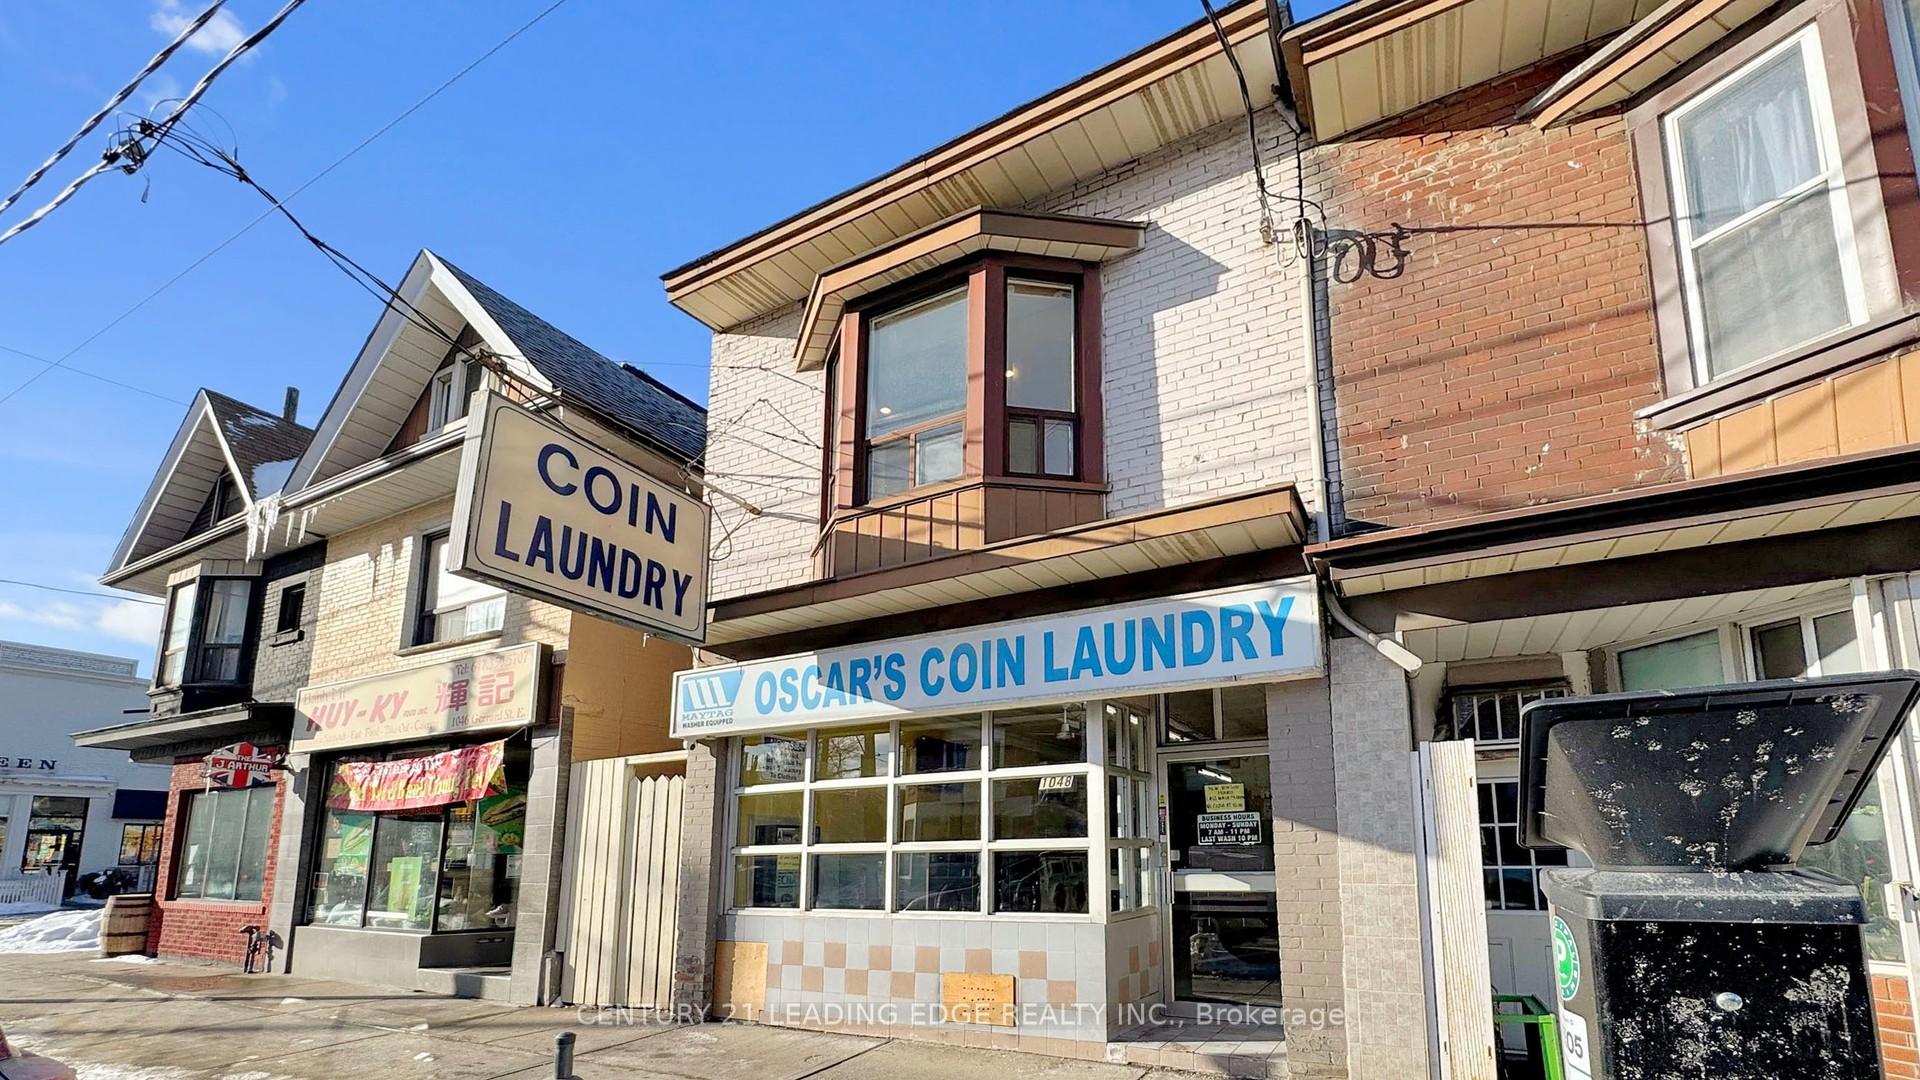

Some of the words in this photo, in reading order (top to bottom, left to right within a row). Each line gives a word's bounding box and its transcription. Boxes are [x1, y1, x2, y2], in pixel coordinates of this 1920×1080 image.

[537, 443, 677, 544] COIN
[494, 500, 693, 617] LAUNDRY
[754, 652, 906, 715] OSCAR'S
[919, 635, 1025, 697] COIN
[1043, 595, 1296, 683] LAUNDRY
[306, 689, 409, 732] HUY-KY
[682, 709, 734, 721] MAYTAG
[452, 714, 470, 727] 1046
[682, 720, 705, 729] WASHER
[706, 717, 734, 727] EQUIPPED
[216, 760, 225, 769] J
[227, 761, 269, 772] ARTHUR
[1042, 776, 1072, 788] 1048
